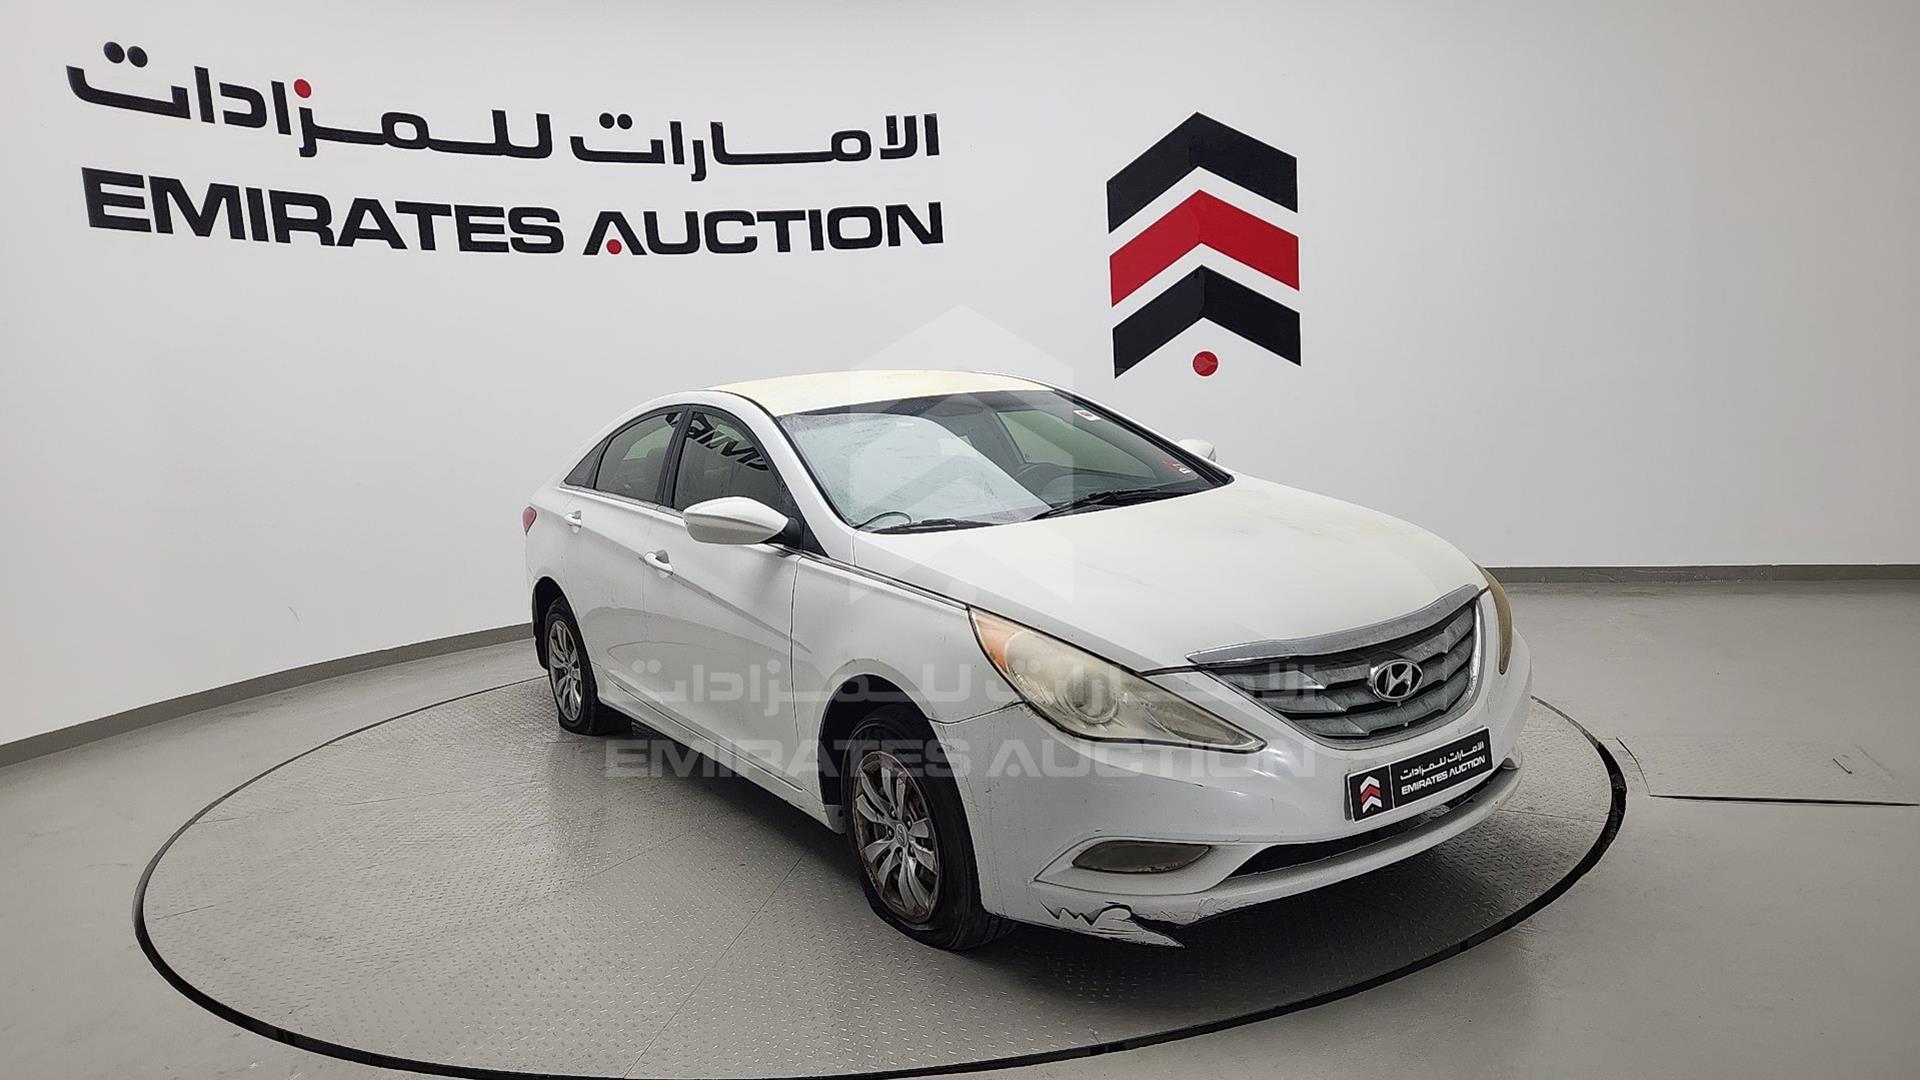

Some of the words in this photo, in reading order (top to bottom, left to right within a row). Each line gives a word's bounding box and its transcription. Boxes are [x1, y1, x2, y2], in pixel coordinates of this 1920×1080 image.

[65, 41, 553, 160] للمزادات
[570, 112, 940, 182] الامارات
[81, 166, 565, 254] EMIRATES
[582, 201, 944, 256] AUCTION
[1402, 770, 1448, 795] EMIRATES
[1449, 755, 1485, 777] AUCTION
